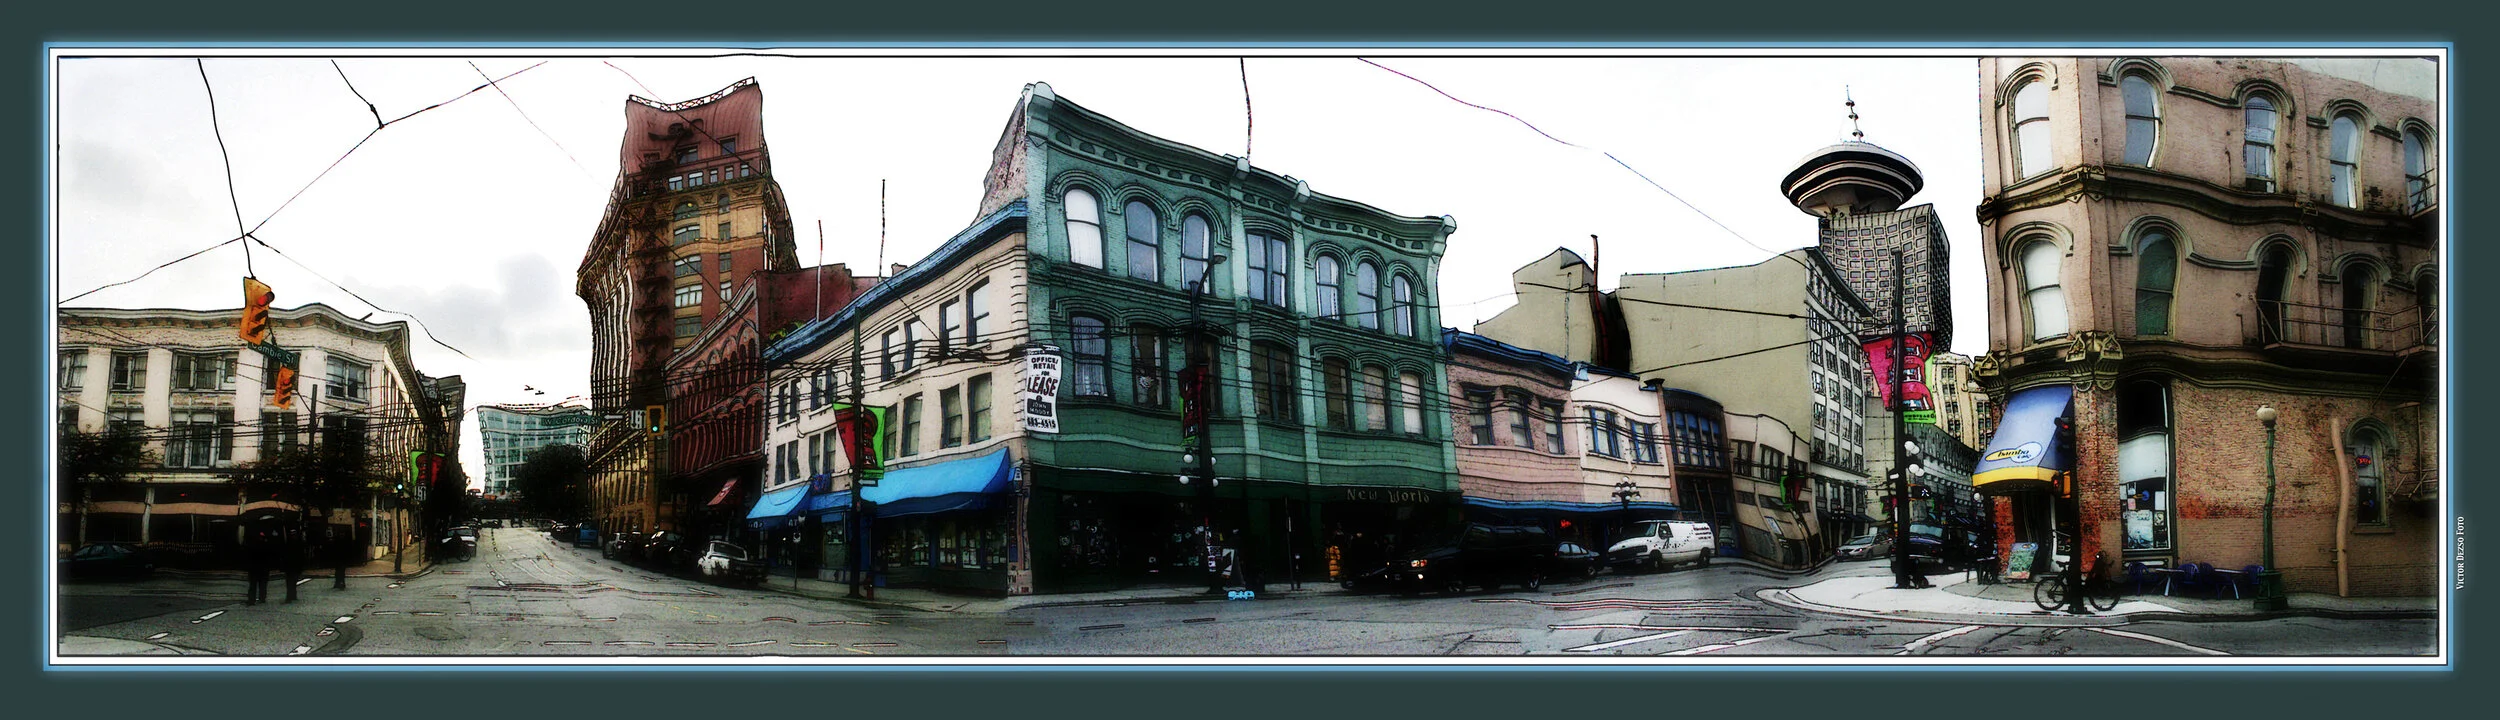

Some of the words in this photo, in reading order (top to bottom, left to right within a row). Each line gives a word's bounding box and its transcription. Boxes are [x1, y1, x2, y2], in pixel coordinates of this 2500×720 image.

[1027, 376, 1059, 397] LEASE
[555, 416, 588, 425] Cordova
[1347, 488, 1378, 501] New
[1387, 489, 1430, 504] World
